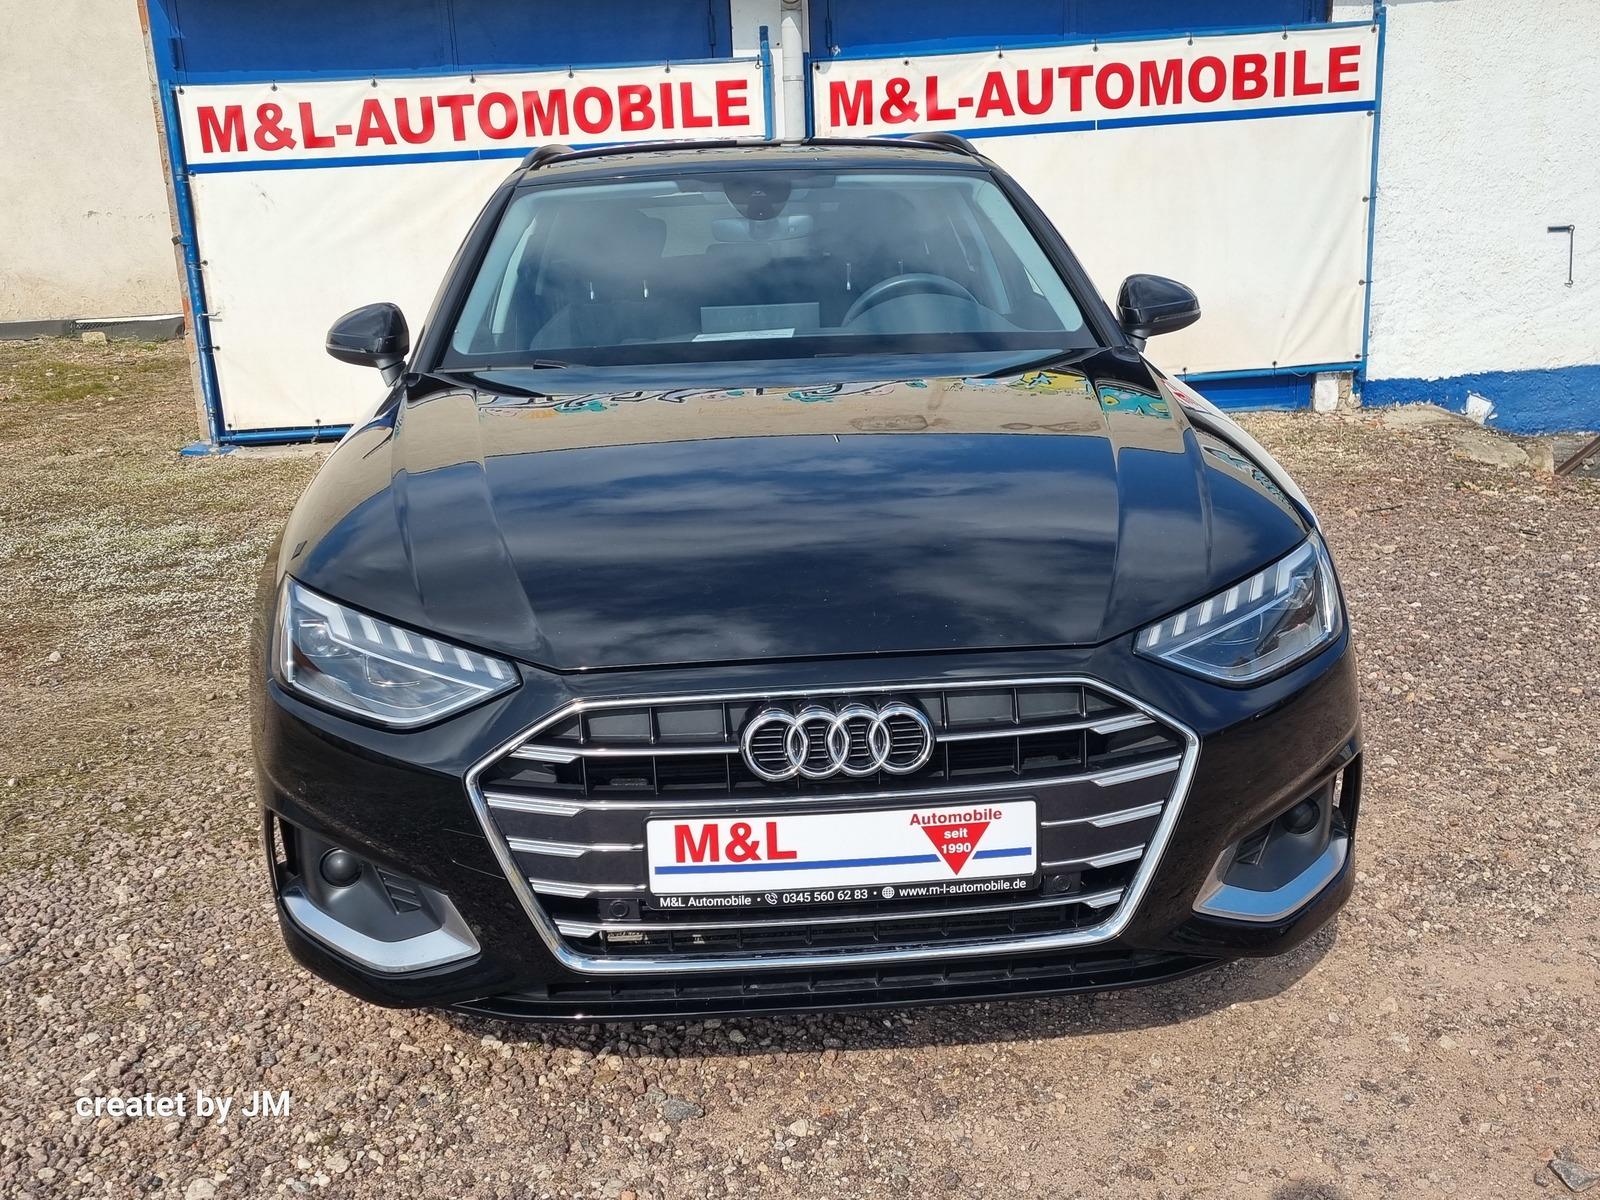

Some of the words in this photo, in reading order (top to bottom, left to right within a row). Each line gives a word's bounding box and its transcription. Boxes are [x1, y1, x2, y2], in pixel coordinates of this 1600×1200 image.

[829, 45, 1361, 127] M&L-AUTOMOBILE
[196, 79, 750, 153] M&L-AUTOMOBILE
[909, 808, 1003, 826] Automobile
[674, 822, 797, 863] M&L
[944, 828, 968, 839] seit
[941, 842, 972, 854] 1990
[660, 897, 685, 907] M&L
[688, 895, 751, 907] Automobile
[783, 893, 811, 904] 0345
[813, 891, 834, 902] 560
[837, 890, 851, 901] 62
[854, 889, 868, 900] 83
[899, 879, 1027, 897] www.m-l-automobile.de
